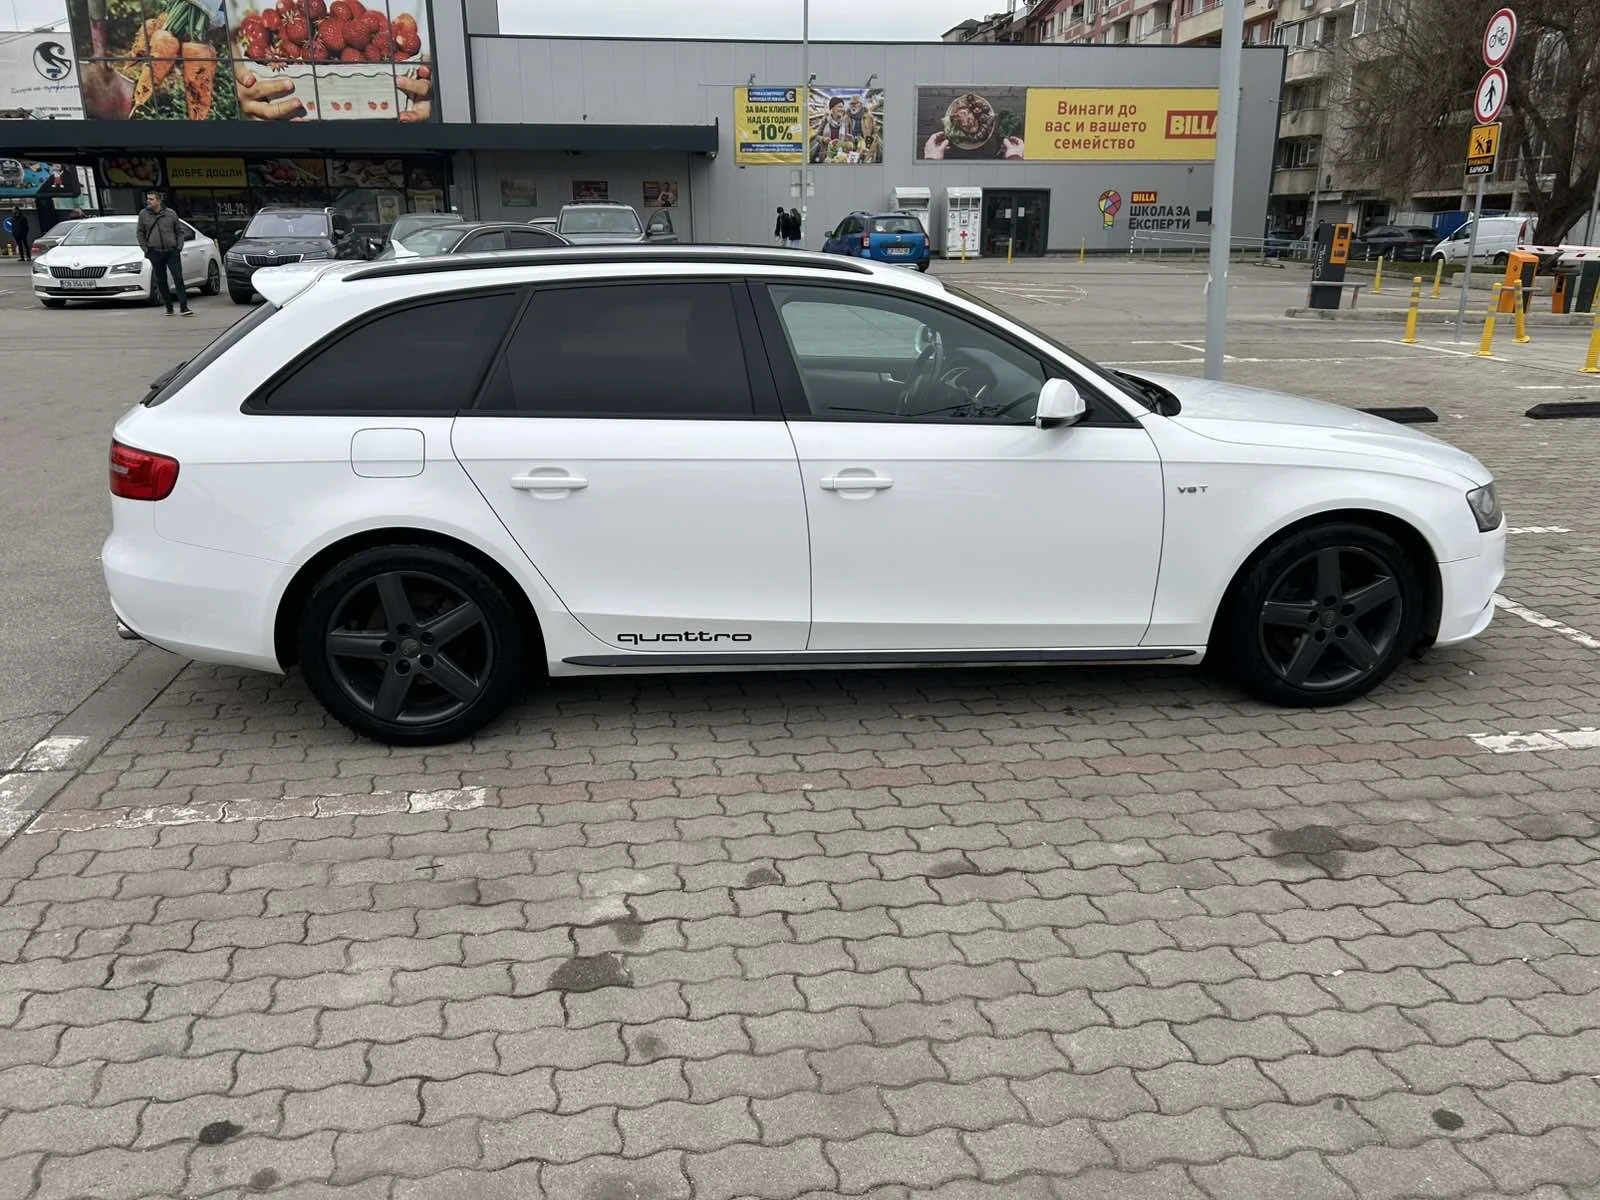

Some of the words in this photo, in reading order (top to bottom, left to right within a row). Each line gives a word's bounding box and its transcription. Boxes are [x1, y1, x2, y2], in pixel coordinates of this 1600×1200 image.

[745, 105, 754, 113] ЗА
[755, 105, 768, 113] ВАС
[769, 105, 799, 114] КЛИЕНТИ
[1057, 101, 1114, 116] Винаги
[1118, 104, 1137, 118] до
[747, 116, 761, 124] НАД
[771, 116, 798, 124] ГОДИНИ
[752, 124, 793, 140] -10%
[1045, 121, 1071, 133] вас
[1075, 121, 1085, 133] и
[1089, 121, 1147, 133] вашето
[1054, 135, 1136, 150] семейство
[171, 168, 204, 177] ДОБРЕ
[206, 168, 242, 178] ДОШЛИ
[1132, 193, 1155, 202] BILLA
[1129, 206, 1174, 217] ШКОЛА
[1175, 206, 1190, 217] ЗА
[1129, 218, 1190, 230] ЕКСПЕРТИ
[617, 631, 752, 645] quattro
